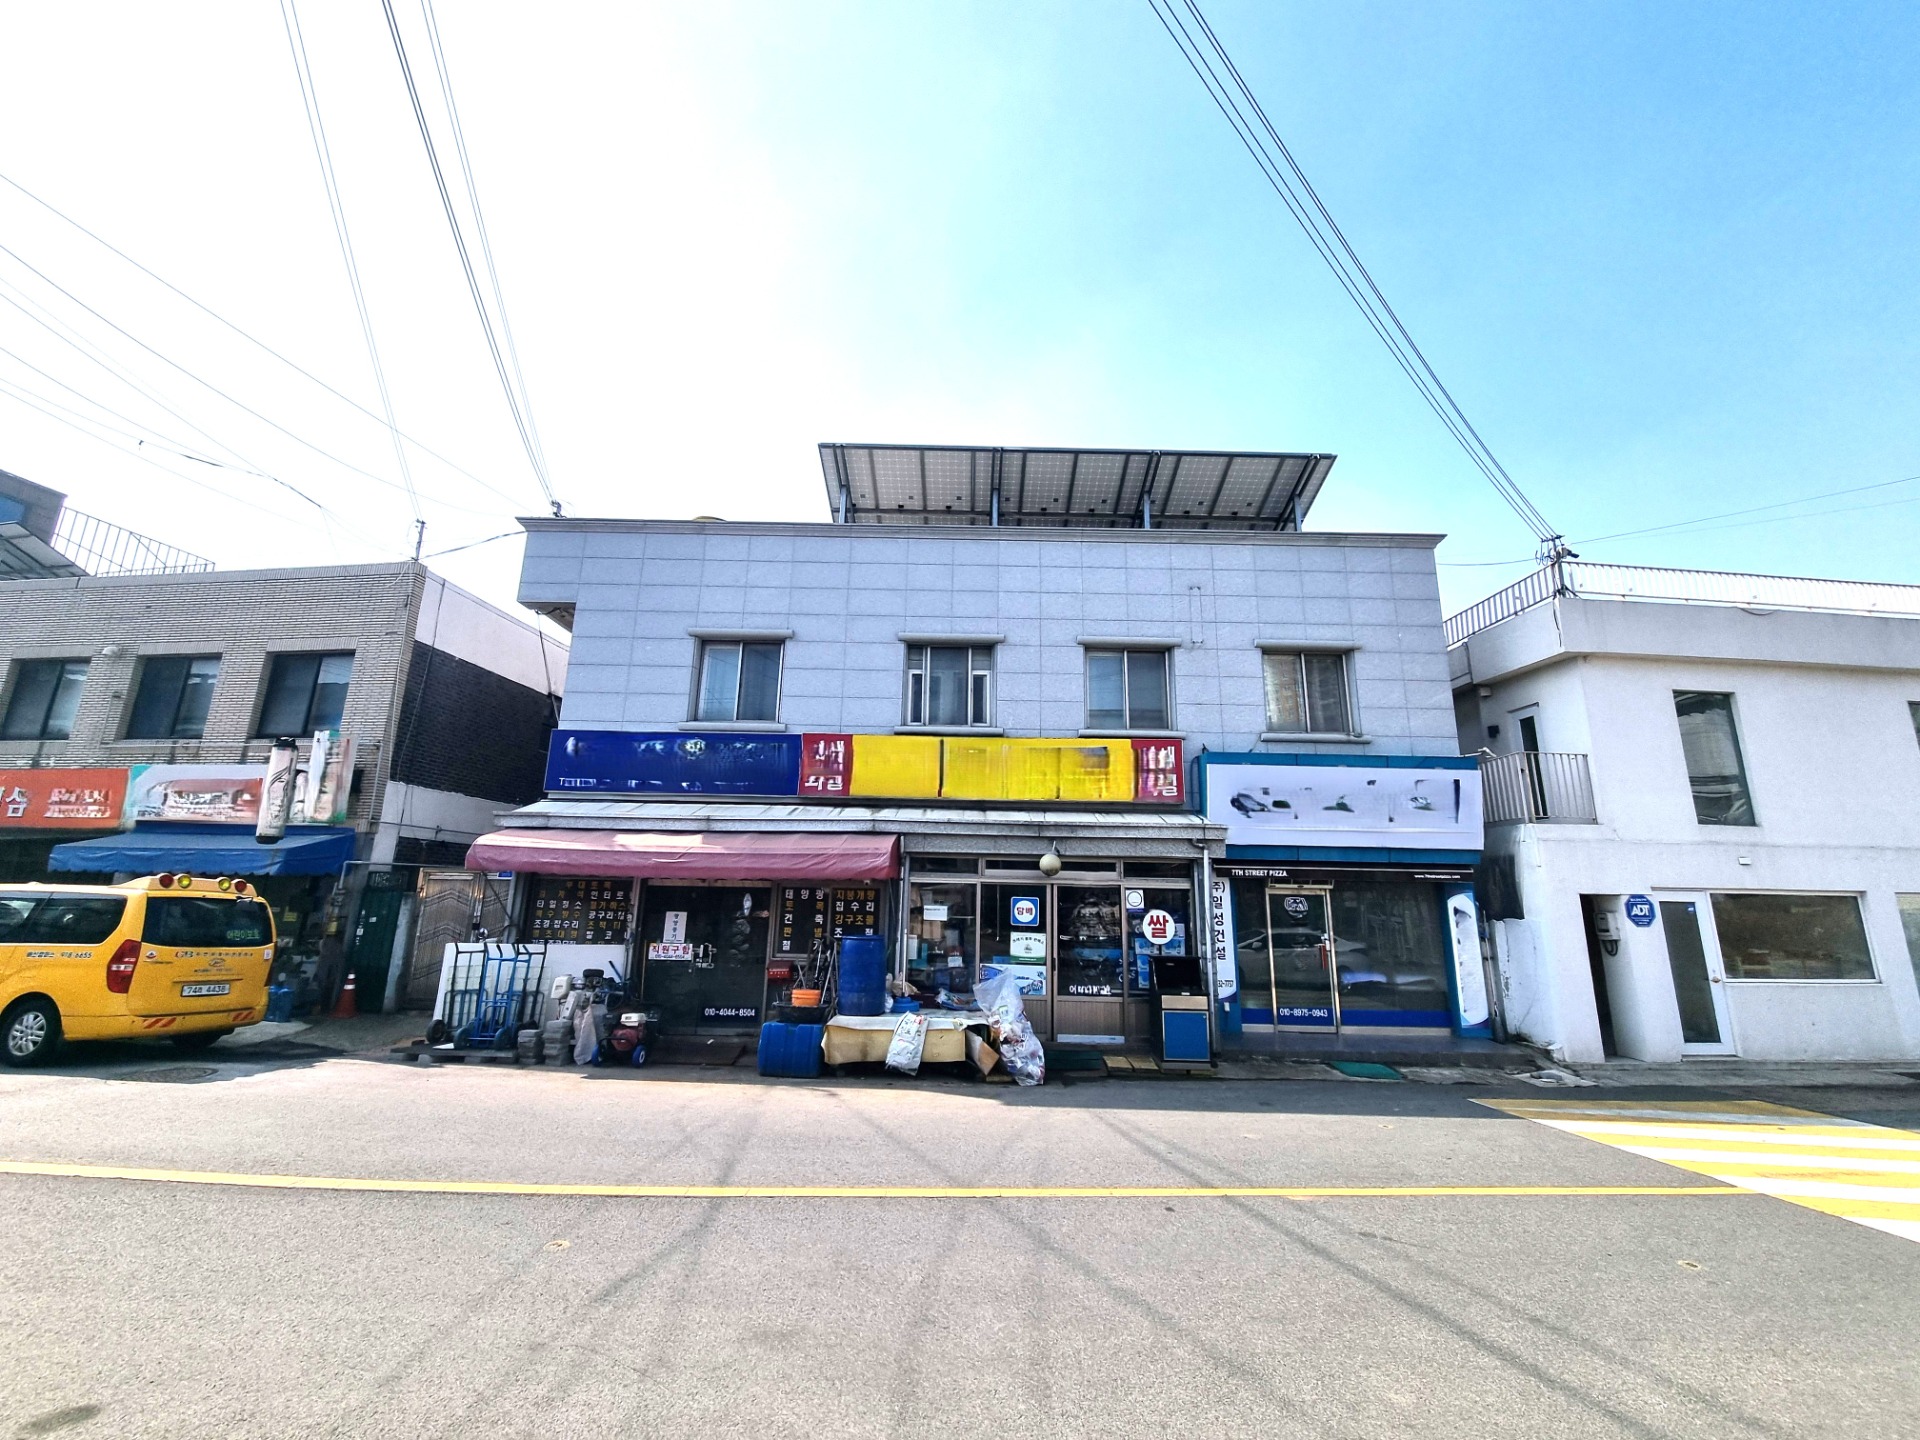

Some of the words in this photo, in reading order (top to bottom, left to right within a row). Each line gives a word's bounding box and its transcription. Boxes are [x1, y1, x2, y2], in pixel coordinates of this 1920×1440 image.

[1016, 906, 1033, 916] 담배
[1630, 904, 1650, 916] ADT
[1147, 914, 1170, 939] 쌀
[704, 1008, 756, 1017] 010-4044-8504
[1279, 1008, 1328, 1018] 010-8975-0943
